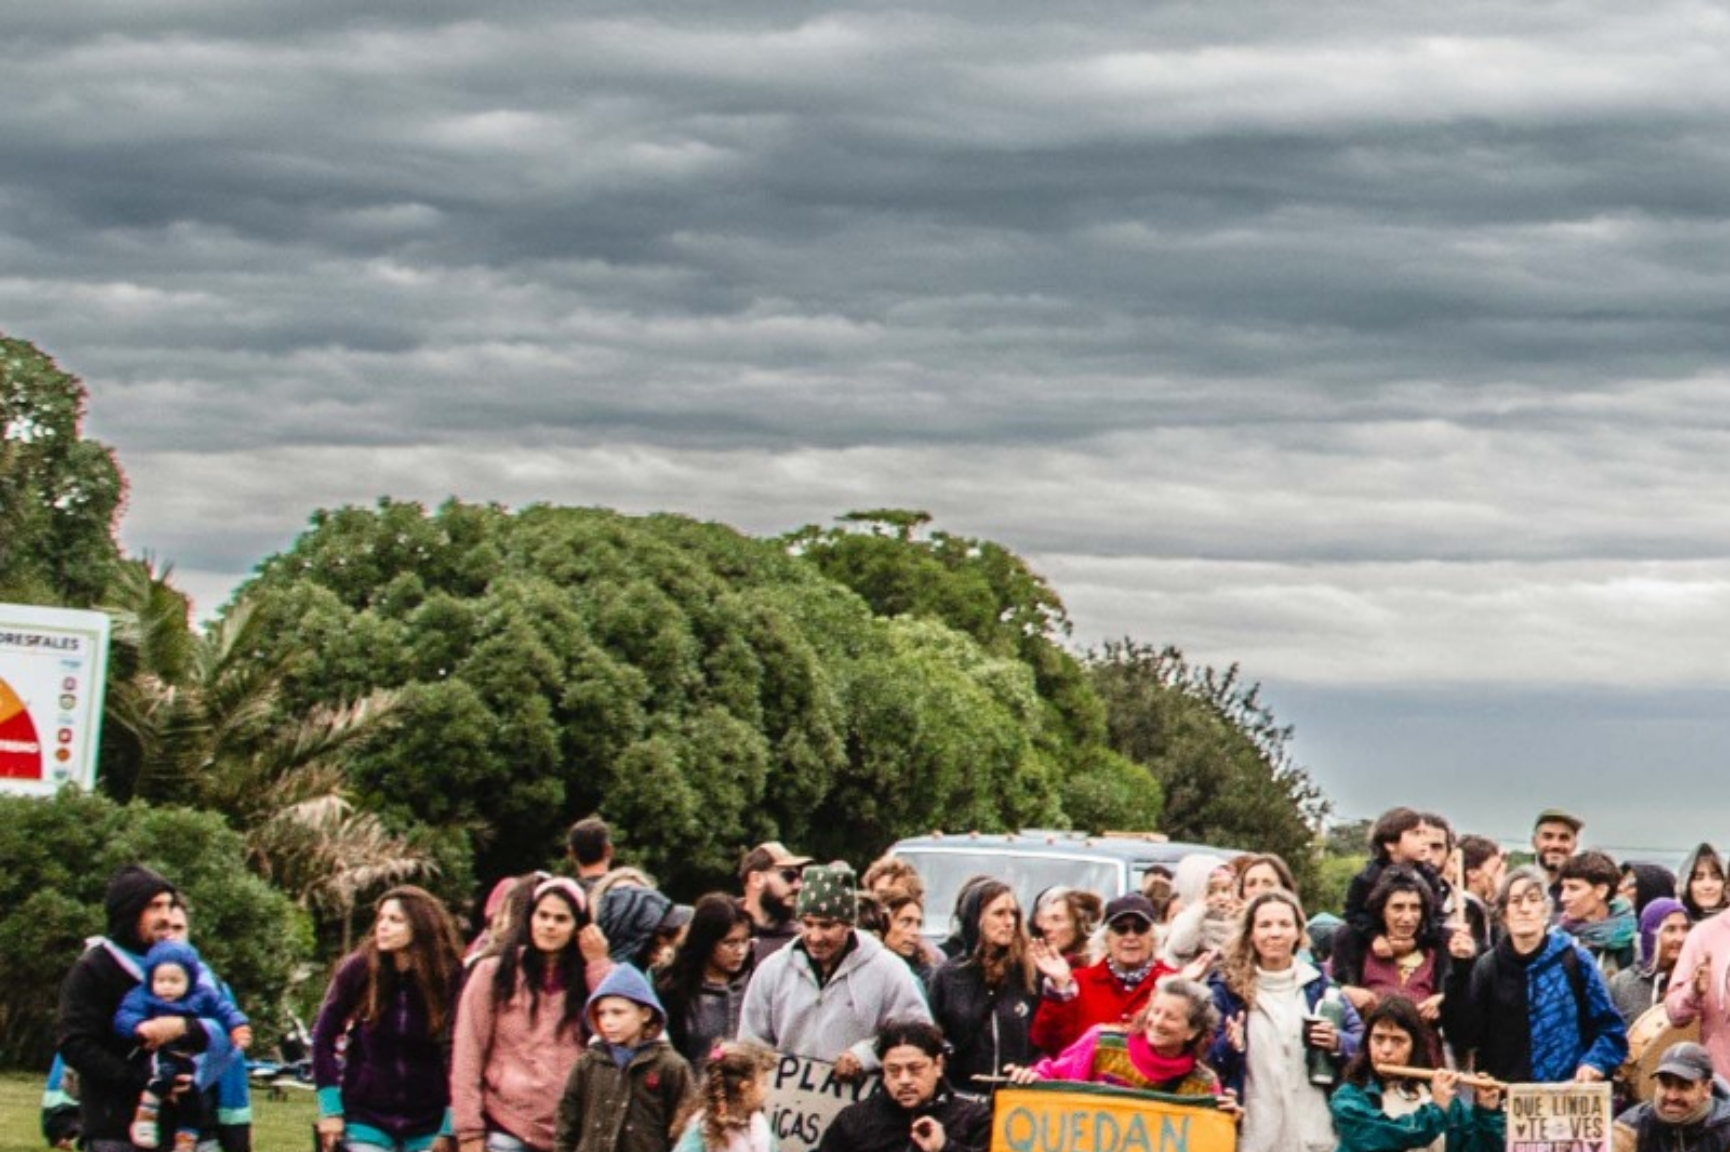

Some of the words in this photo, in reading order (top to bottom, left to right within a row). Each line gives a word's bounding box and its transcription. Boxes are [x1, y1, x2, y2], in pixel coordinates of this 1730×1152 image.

[1513, 1096, 1542, 1118] QUE
[1552, 1096, 1603, 1117] LINDA
[1527, 1117, 1549, 1140] TE
[1569, 1117, 1604, 1139] VES
